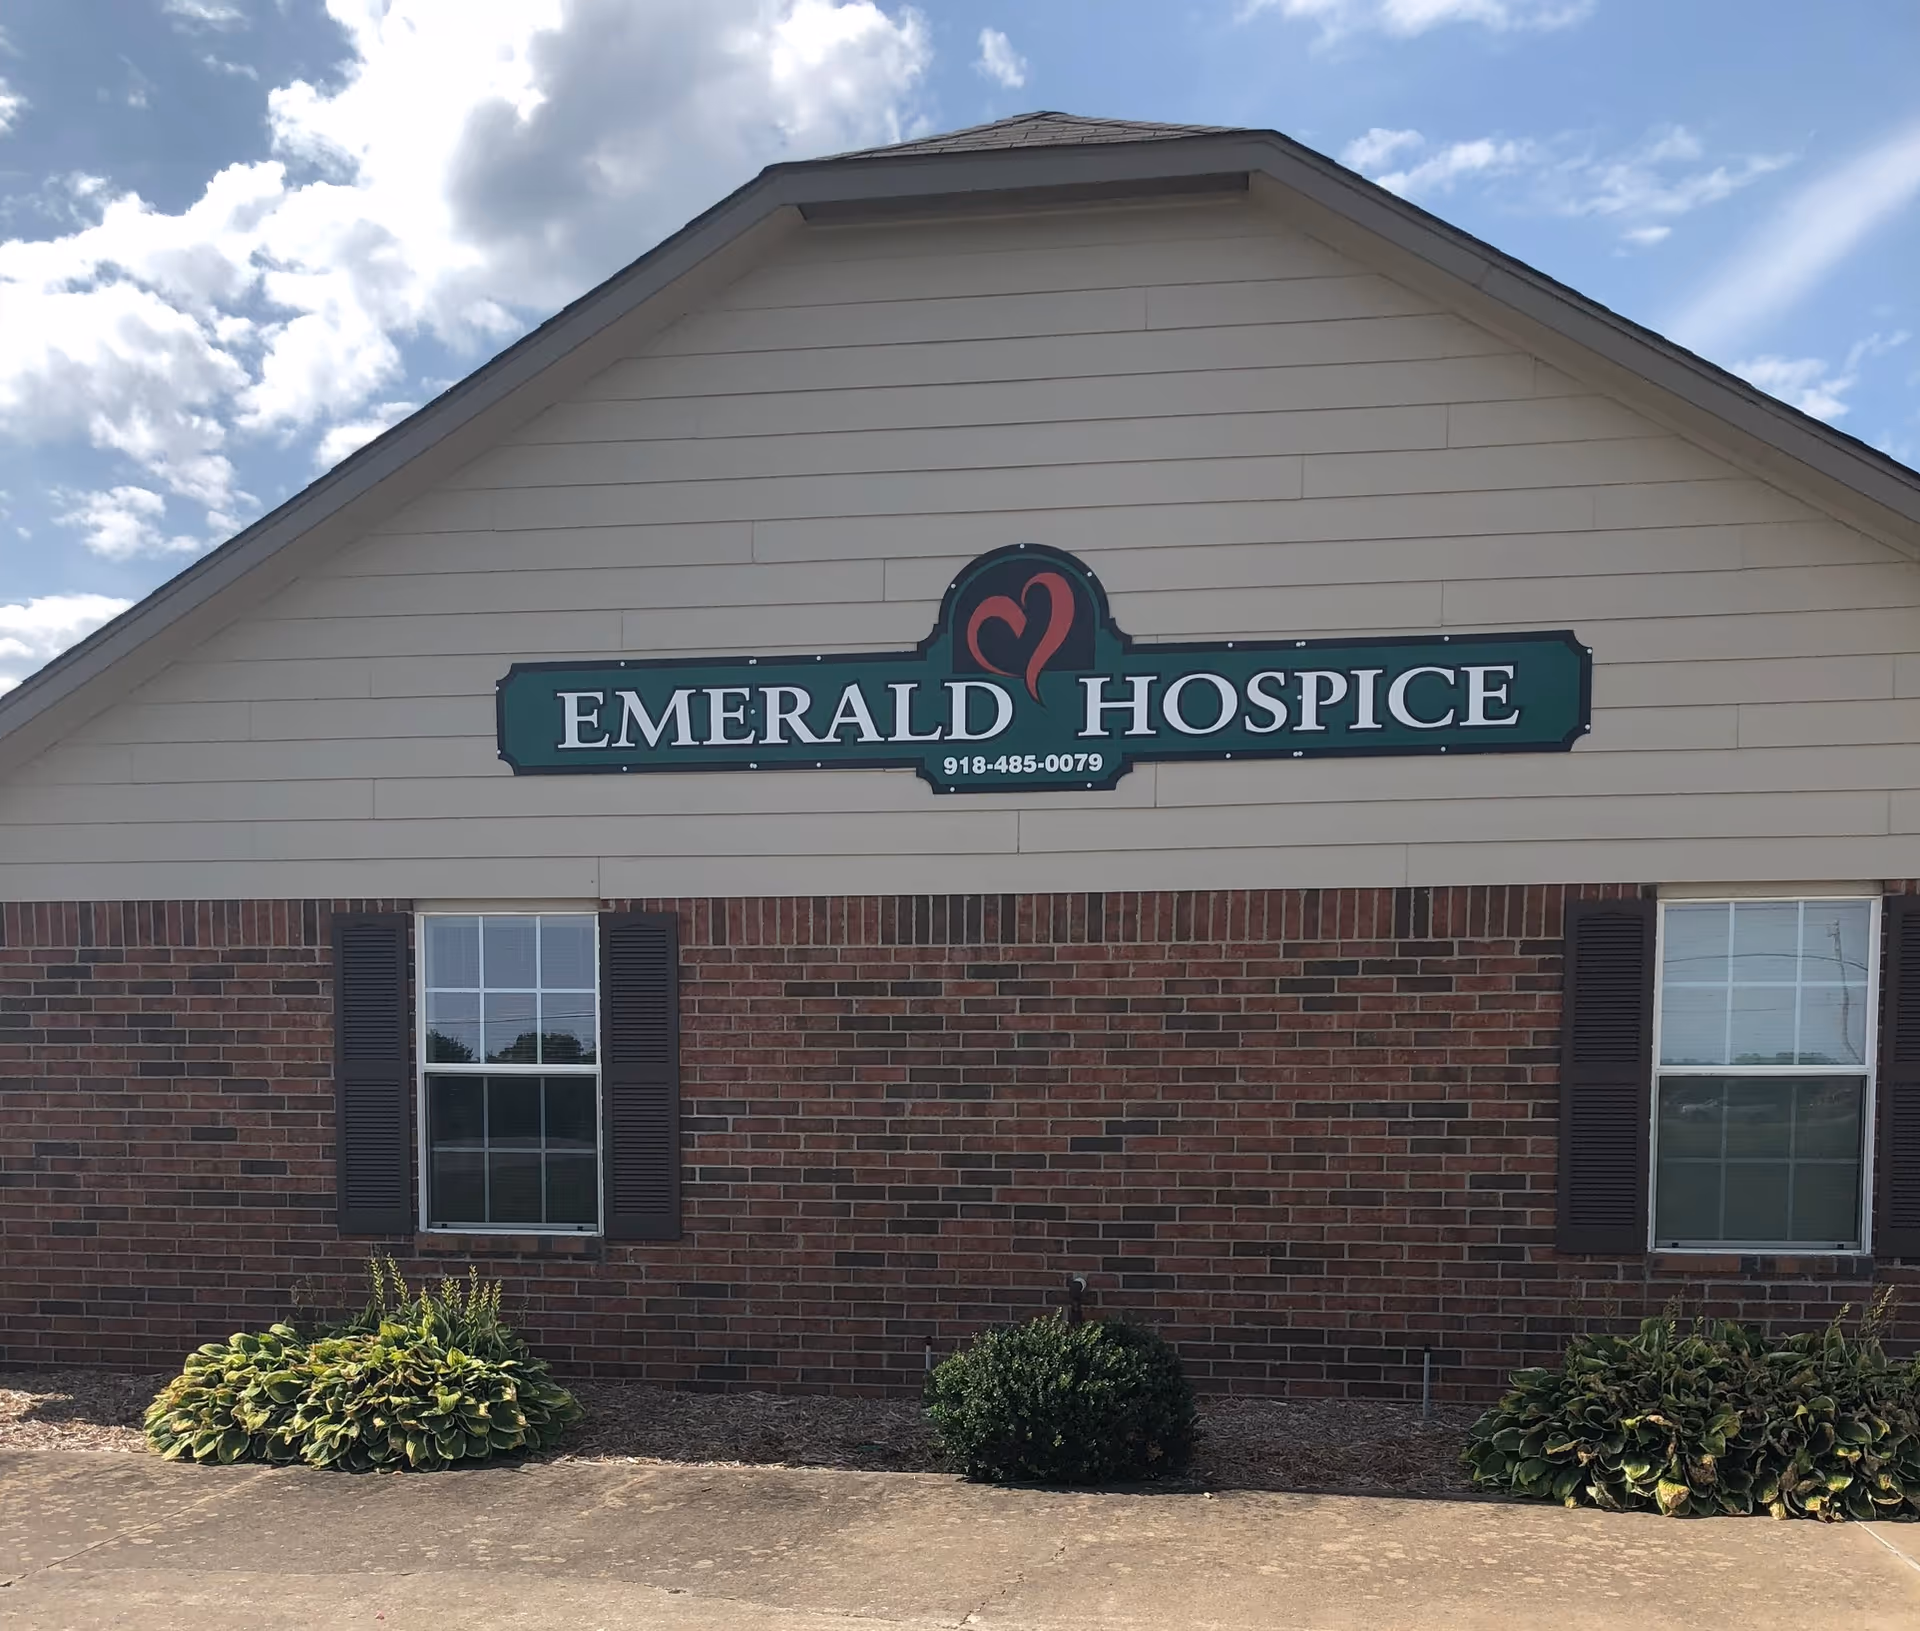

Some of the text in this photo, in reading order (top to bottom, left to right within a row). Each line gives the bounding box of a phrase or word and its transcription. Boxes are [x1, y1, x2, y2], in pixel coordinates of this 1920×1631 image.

[556, 665, 1520, 749] EMERALD HOSPICE
[943, 753, 1104, 775] 918-485-0079
